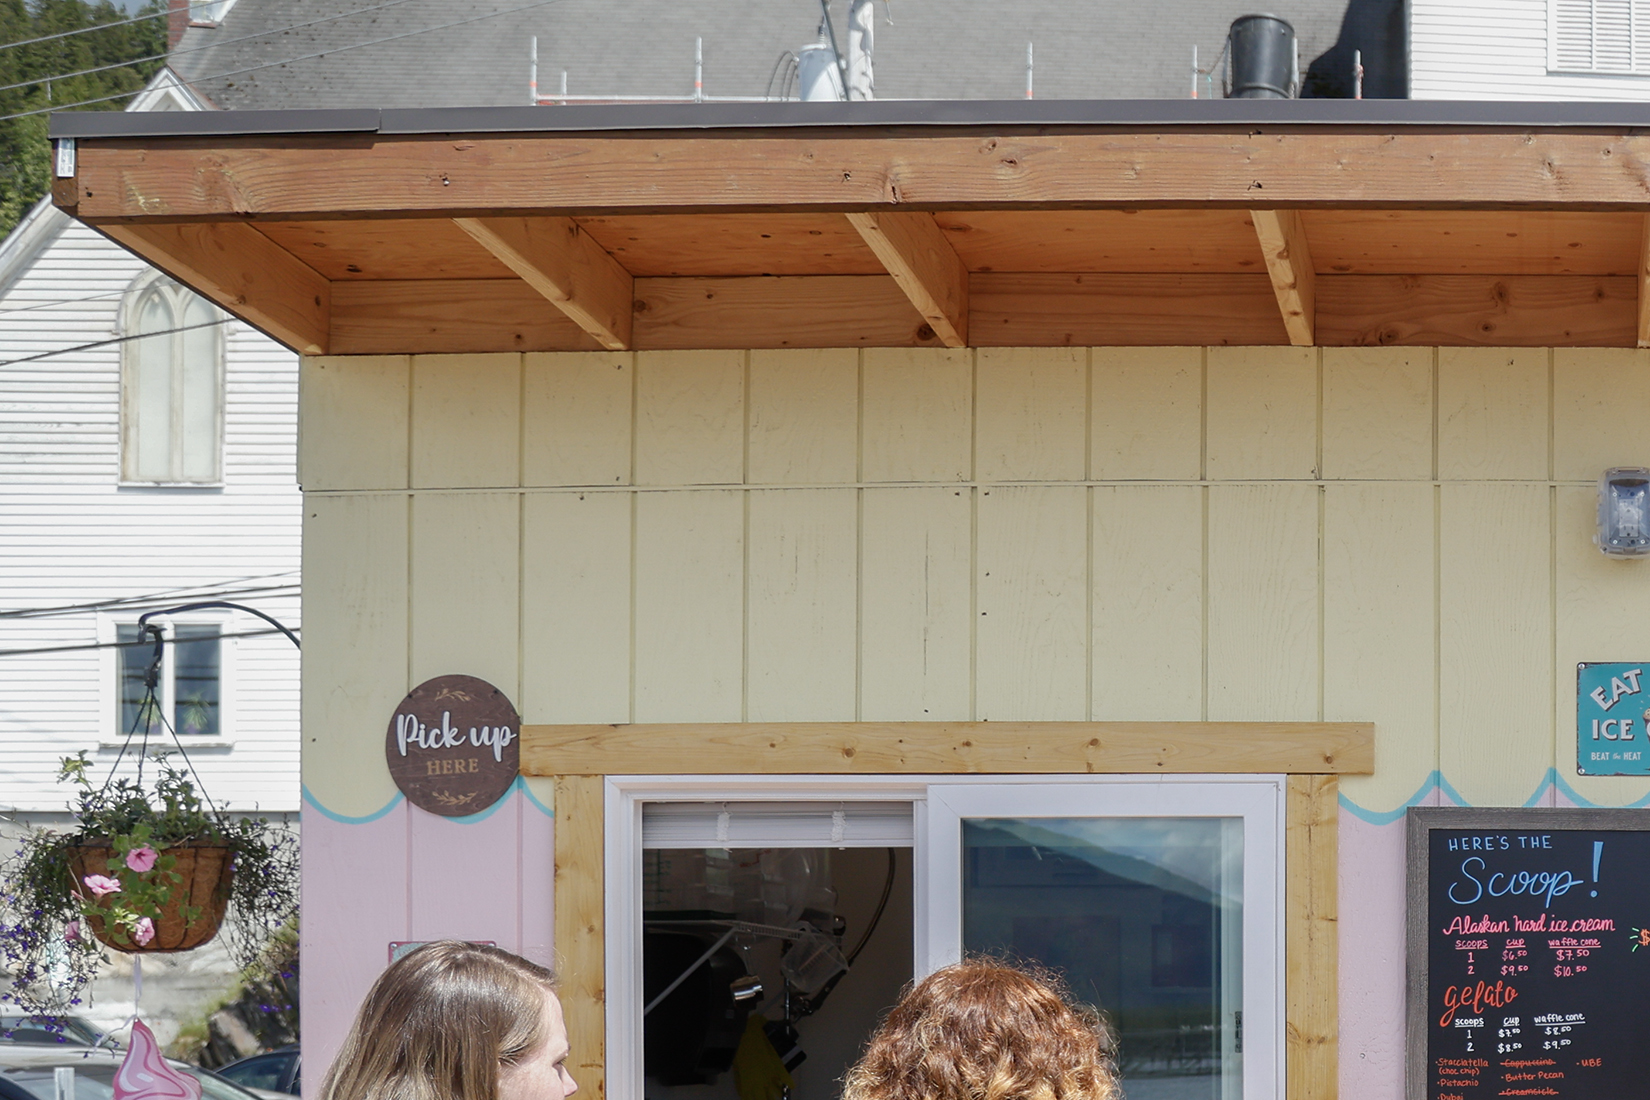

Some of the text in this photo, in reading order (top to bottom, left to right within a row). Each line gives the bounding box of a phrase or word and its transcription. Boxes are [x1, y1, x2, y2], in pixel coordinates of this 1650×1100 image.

[1590, 669, 1642, 712] EAT
[397, 711, 517, 762] Pick up
[1592, 719, 1635, 740] ICE
[1591, 752, 1642, 760] BEAT the HEAT
[427, 759, 479, 775] HERE
[1449, 835, 1552, 851] HERE'S THE
[1449, 841, 1604, 908] Scoop!
[1443, 913, 1615, 934] Alaskan hard ice cream
[1455, 939, 1600, 948] scoops cup waffle cone
[1467, 952, 1474, 963] 1
[1556, 950, 1589, 961] $7.50
[1467, 965, 1587, 977] 2 $9.50 $10.50
[1440, 980, 1518, 1027] gelato
[1582, 1058, 1602, 1067] UBE
[1440, 1079, 1479, 1087] Pistachio
[1506, 1071, 1564, 1082] Butter Pecan
